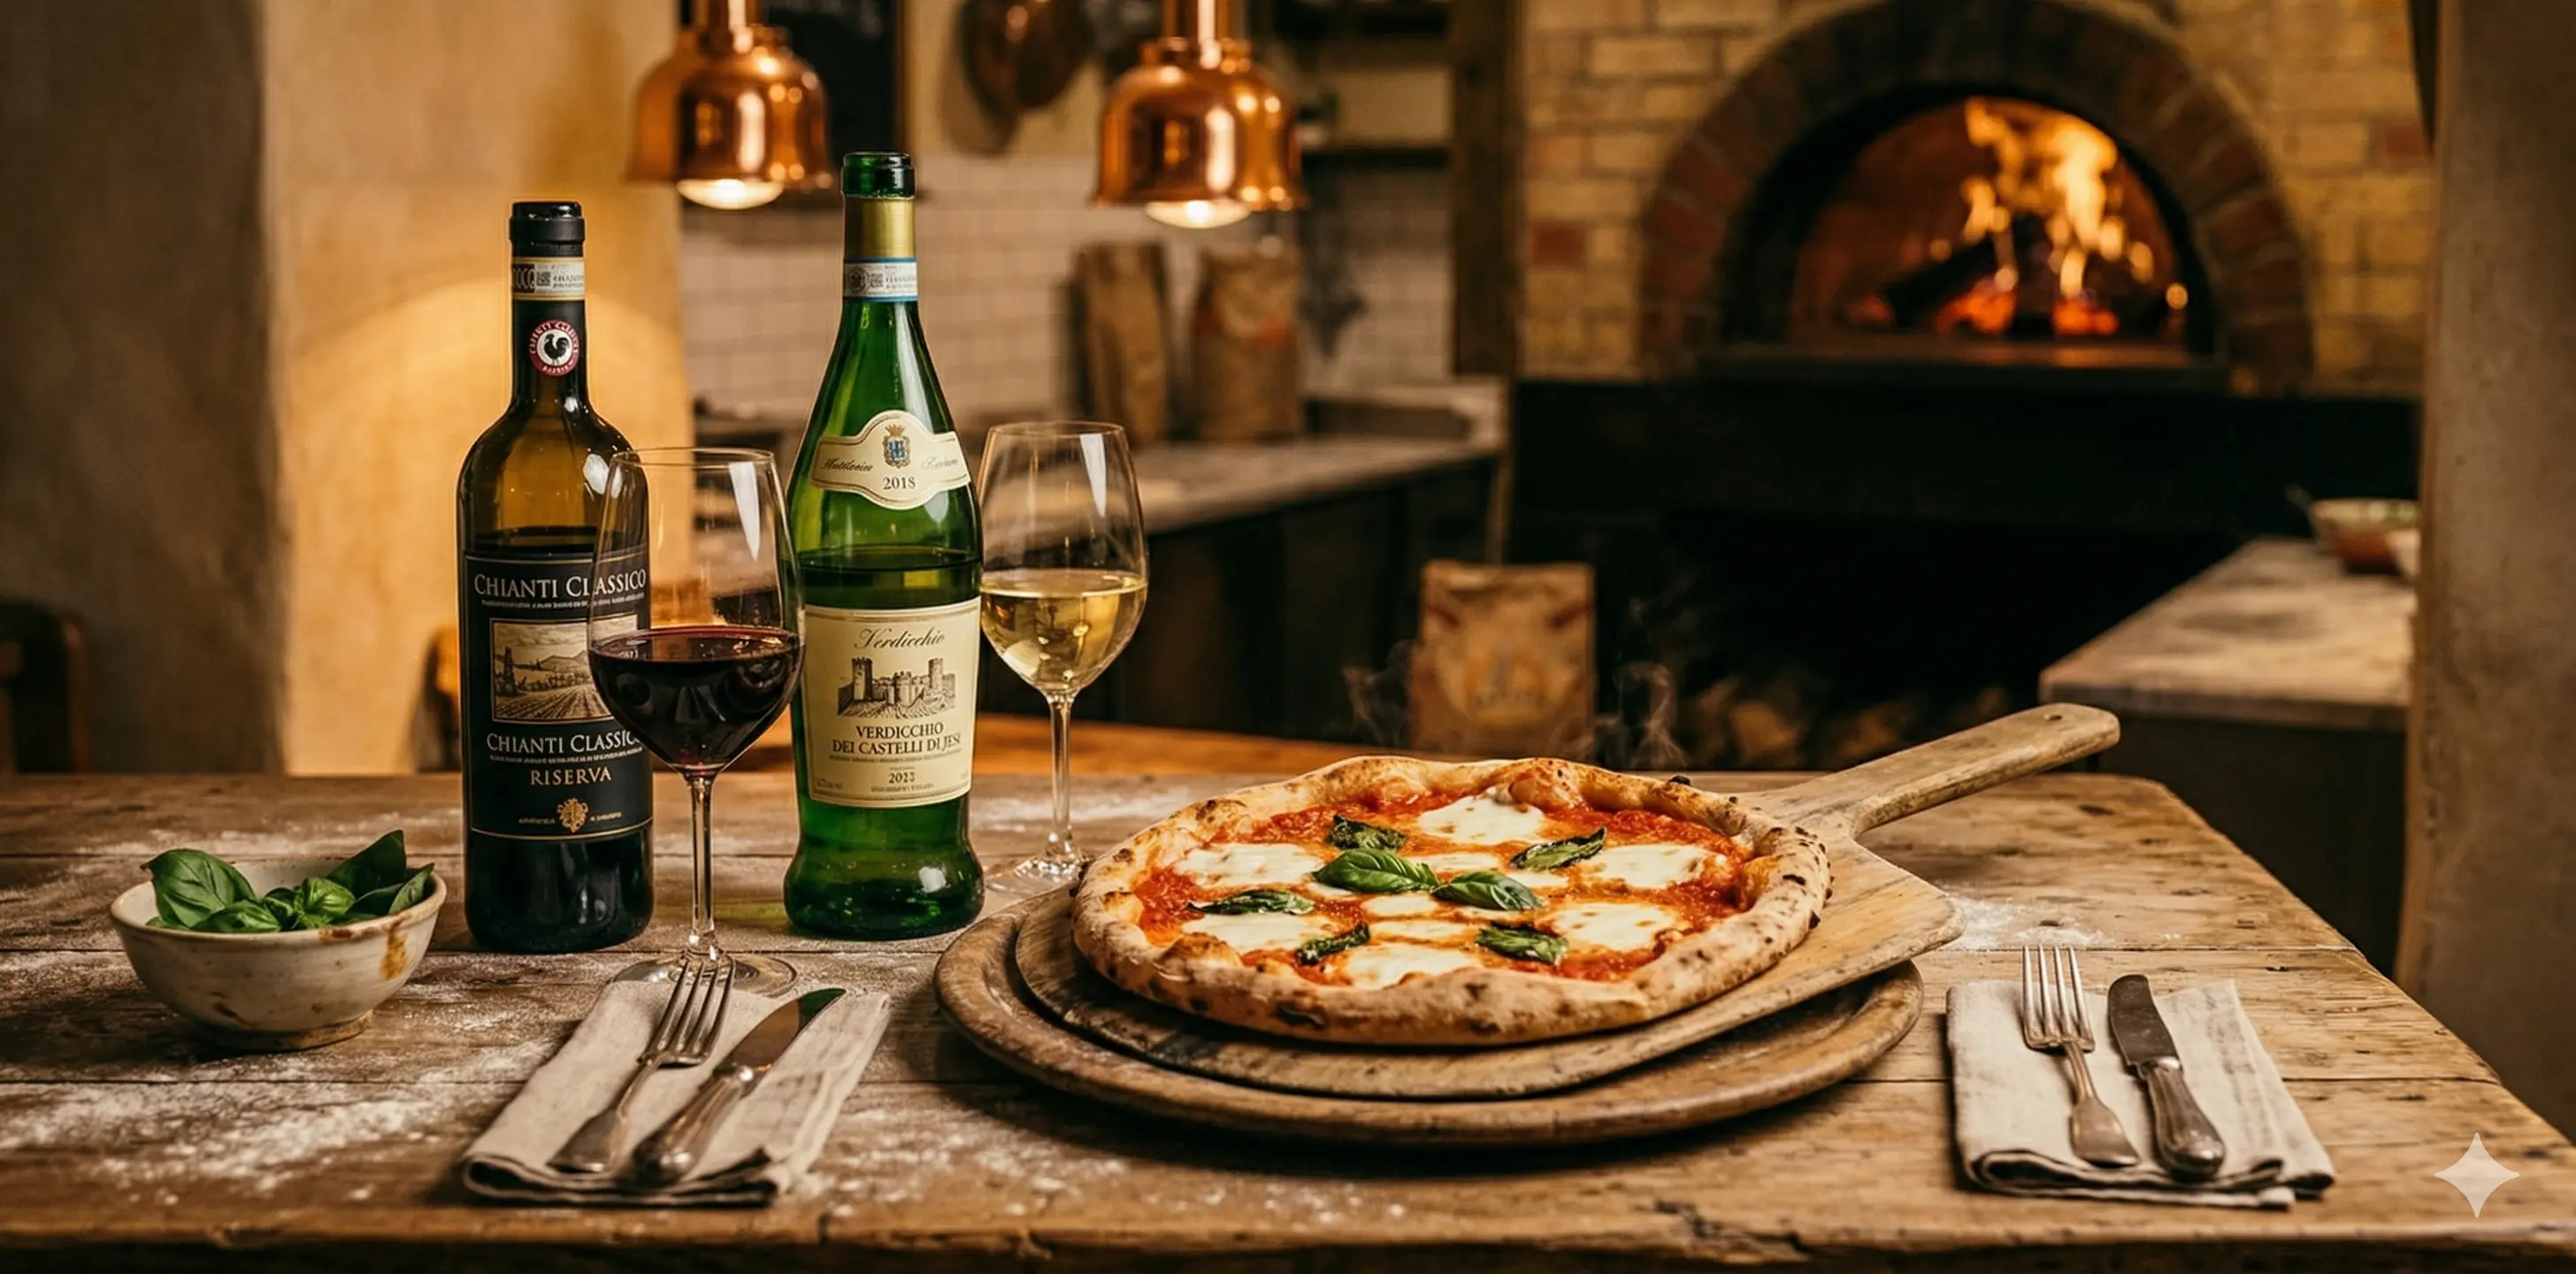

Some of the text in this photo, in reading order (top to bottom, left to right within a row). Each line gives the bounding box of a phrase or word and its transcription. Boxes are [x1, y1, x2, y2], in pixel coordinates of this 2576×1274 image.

[882, 476, 916, 489] 2018
[474, 569, 647, 598] CHIANTI CLASSICO
[854, 626, 945, 649] Verdicchio
[855, 722, 944, 739] VERDICCHIO
[487, 730, 640, 754] CHIANTI CLASSIC
[832, 739, 855, 752] DEI
[858, 740, 923, 755] CASTELLI
[927, 737, 940, 751] DI
[531, 766, 612, 786] RISERVA
